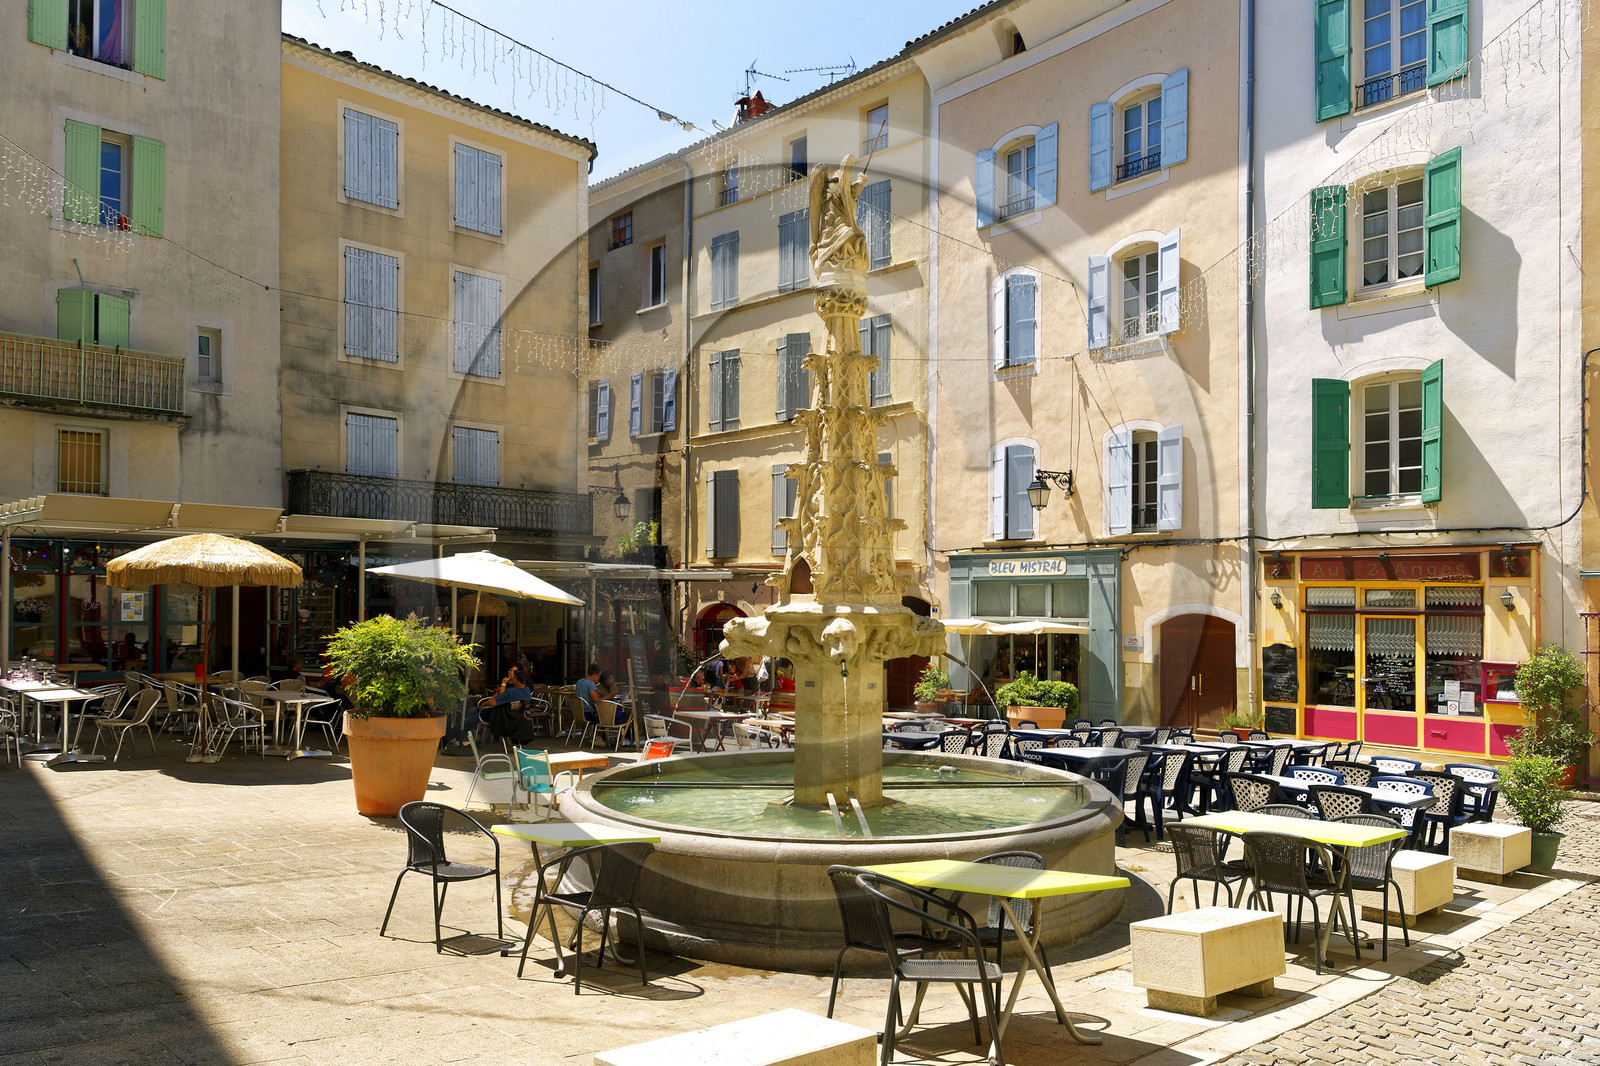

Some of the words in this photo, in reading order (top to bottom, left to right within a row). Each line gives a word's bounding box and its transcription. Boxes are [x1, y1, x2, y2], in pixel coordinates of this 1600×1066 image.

[991, 562, 1015, 573] BLEU
[1020, 560, 1062, 573] MISTRAL
[1312, 563, 1350, 577] Aux
[1367, 562, 1378, 576] 2
[1394, 562, 1465, 579] Anges
